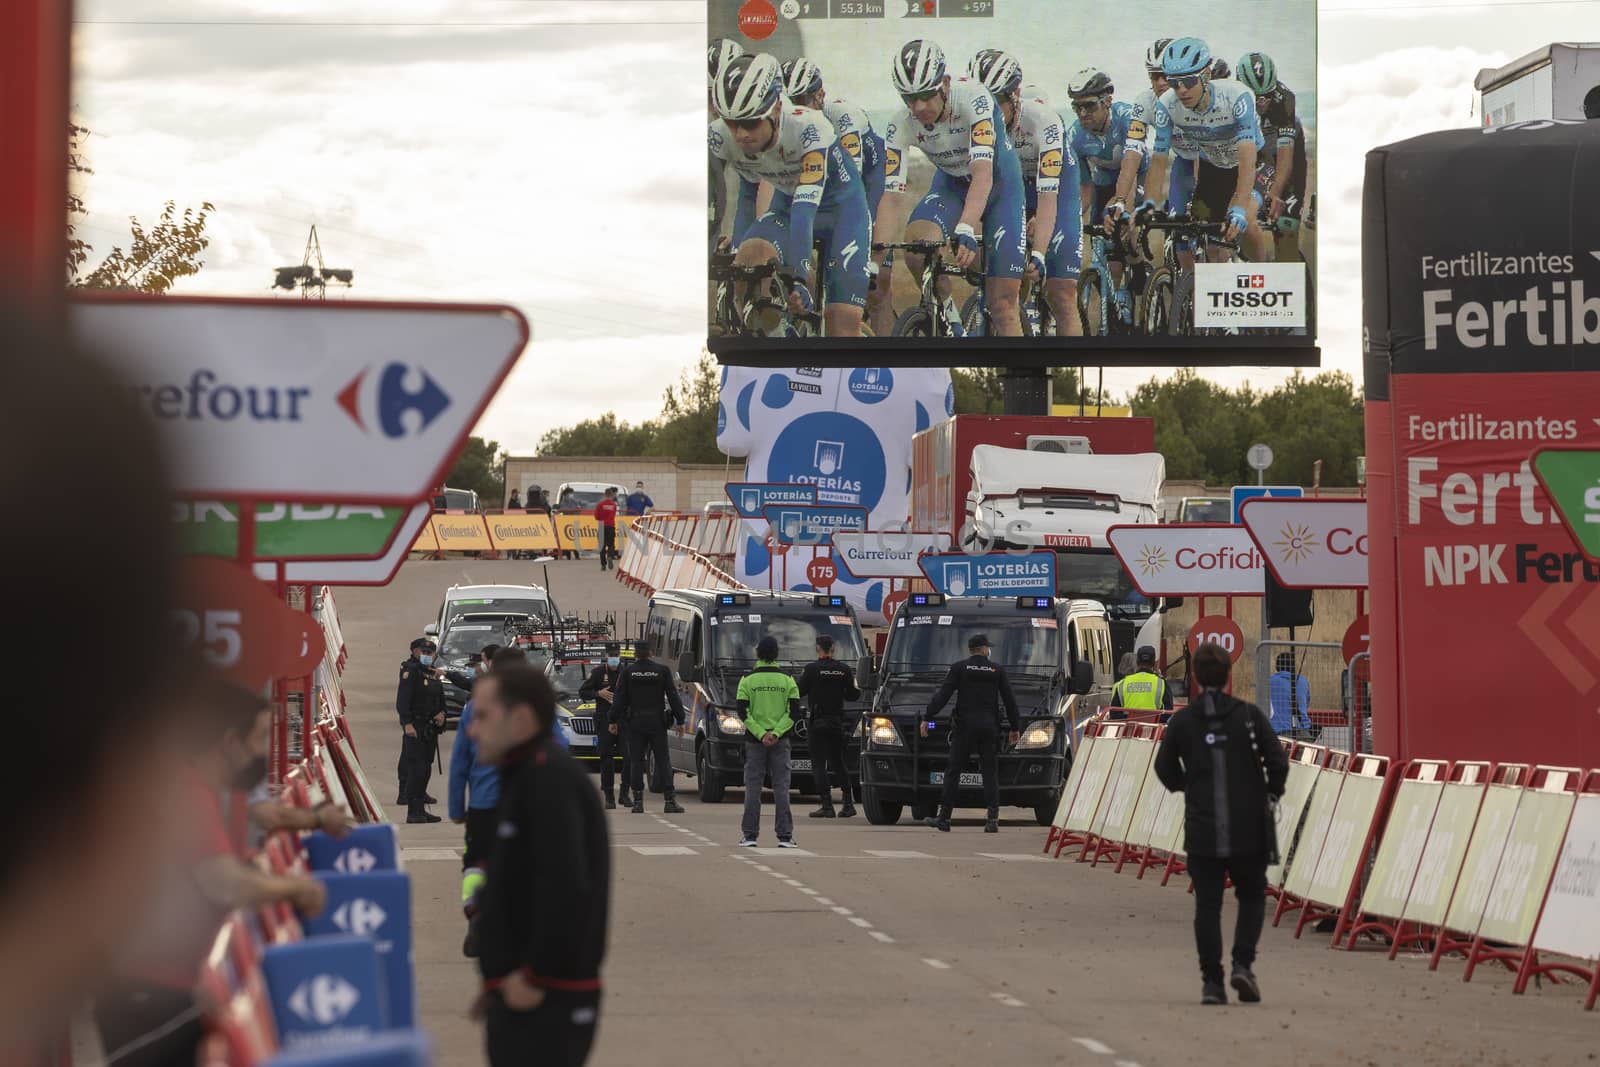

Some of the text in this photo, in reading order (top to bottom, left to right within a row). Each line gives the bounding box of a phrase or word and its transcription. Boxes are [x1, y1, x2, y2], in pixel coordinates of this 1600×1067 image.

[803, 3, 811, 14] 1
[840, 2, 864, 14] 55,3
[866, 2, 882, 14] km
[911, 3, 920, 13] 2
[1421, 250, 1574, 280] Fertilizantes
[1207, 291, 1293, 308] TISSOT
[1408, 413, 1578, 441] Fertilizantes
[788, 474, 862, 492] LOTERÍAS
[763, 490, 813, 501] LOTERÍAS
[1407, 456, 1562, 526] Fert
[806, 513, 862, 525] LOTERÍAS
[493, 523, 541, 541] Continental
[1048, 536, 1088, 547] LA VUELTA
[848, 547, 913, 561] Carrefour
[1175, 547, 1265, 570] Cofidi
[810, 566, 834, 578] 175
[977, 561, 1049, 576] LOTERÍAS
[1424, 543, 1509, 587] NPK
[983, 578, 1044, 587] CON EL DEPORTE
